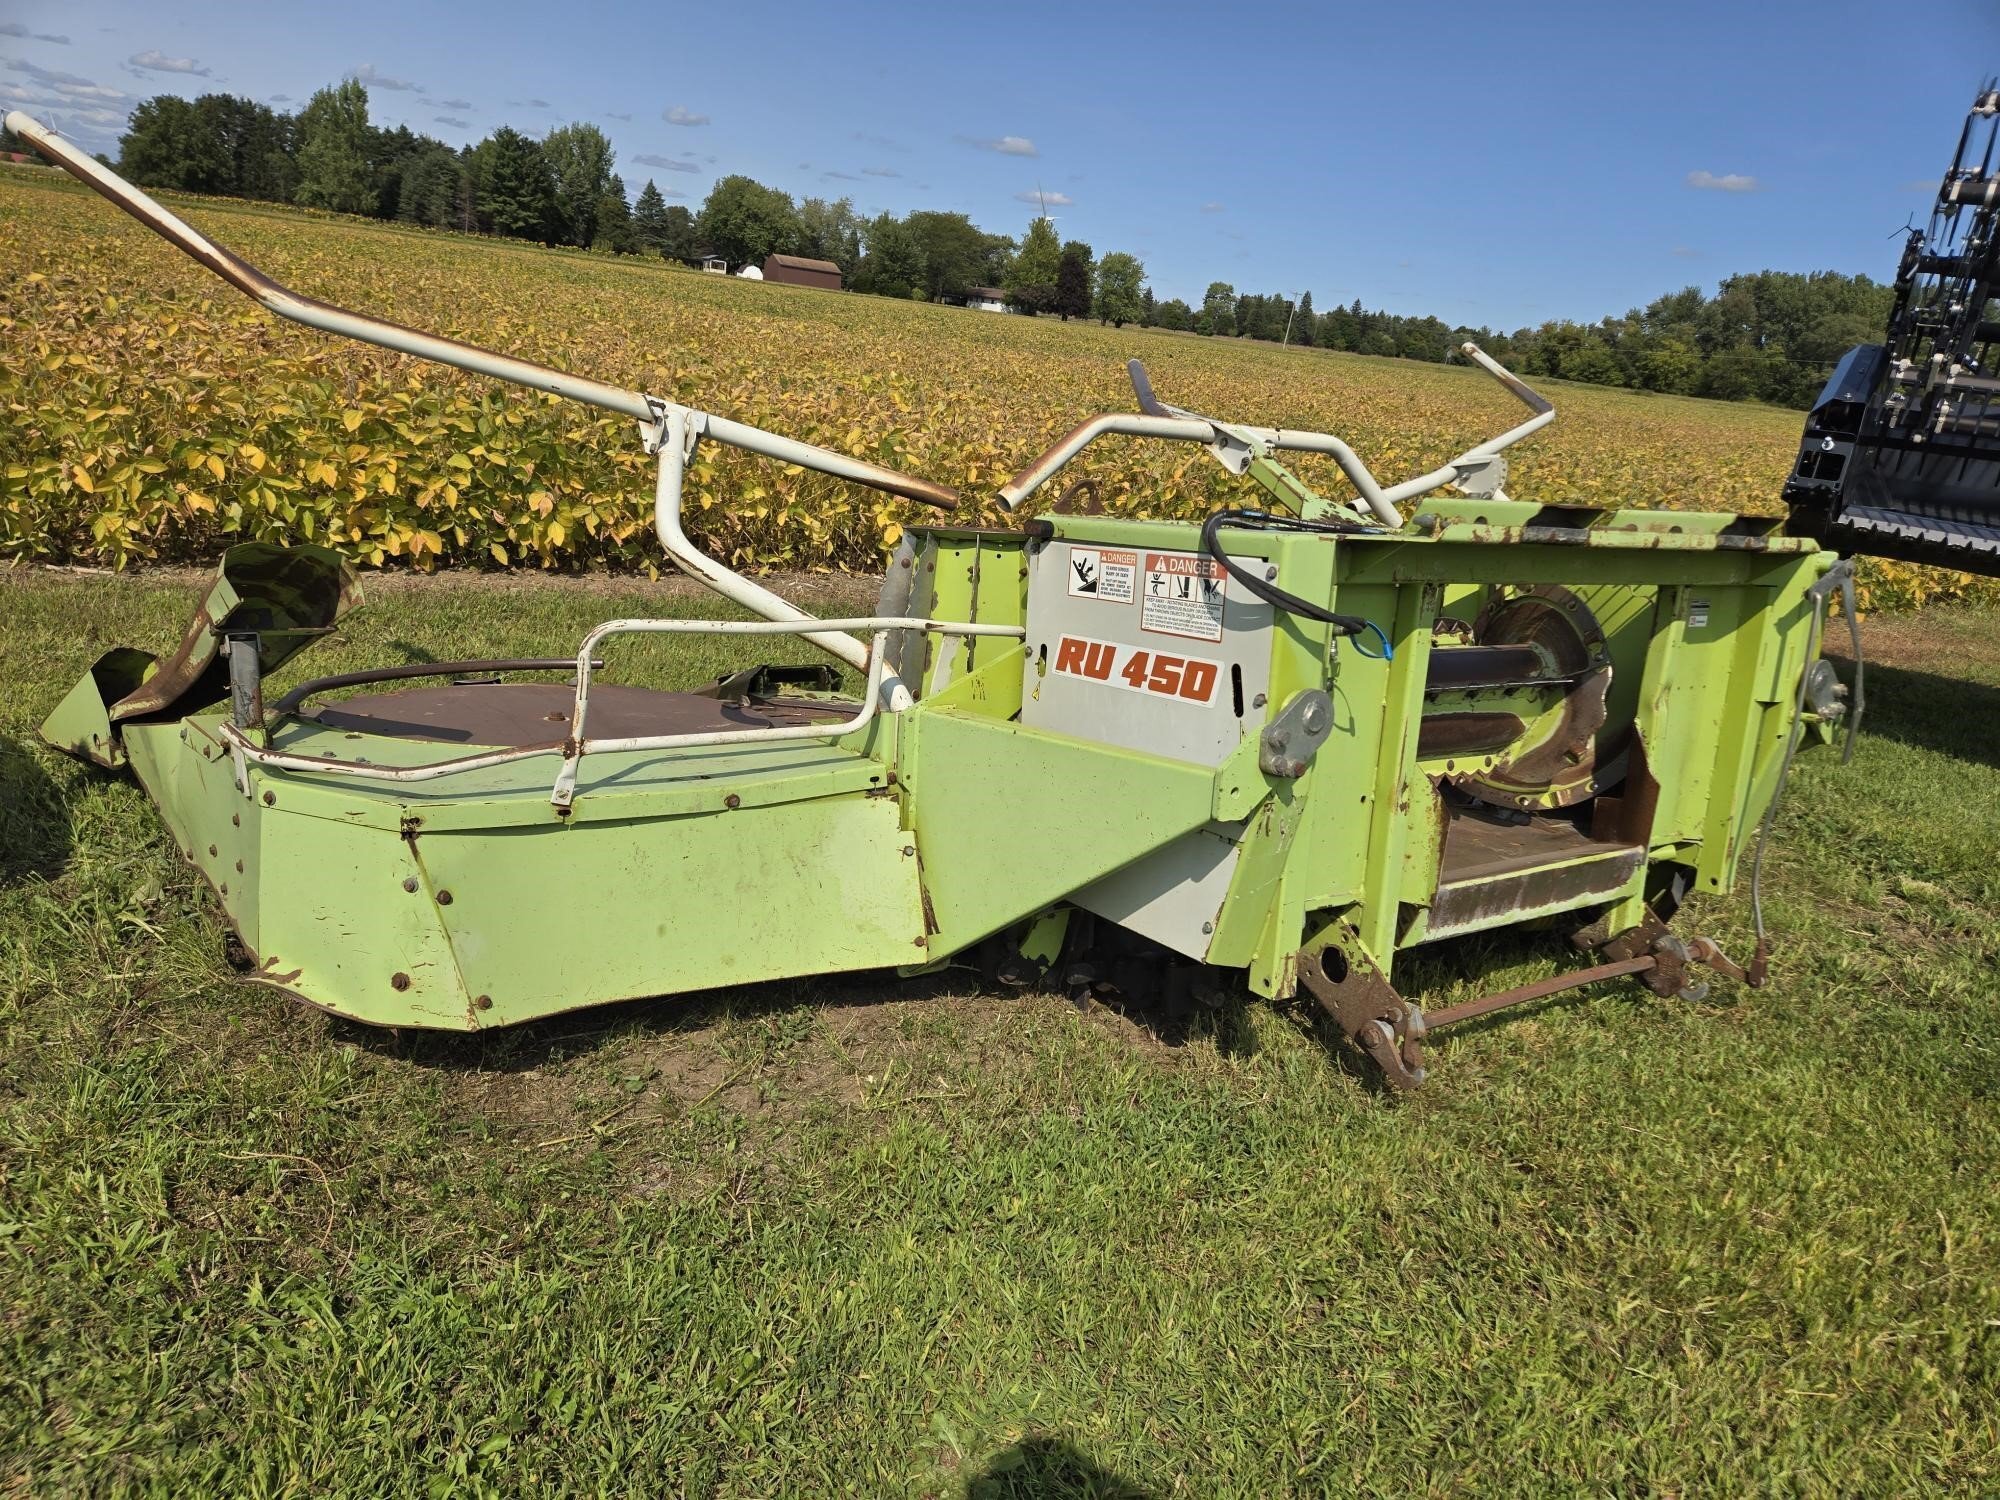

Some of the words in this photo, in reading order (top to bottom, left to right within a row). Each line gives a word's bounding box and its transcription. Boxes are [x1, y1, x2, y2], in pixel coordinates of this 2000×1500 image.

[1107, 552, 1136, 564] DANGER
[1169, 558, 1218, 576] DANGER
[1055, 637, 1117, 681] RU
[1121, 651, 1218, 703] 450
